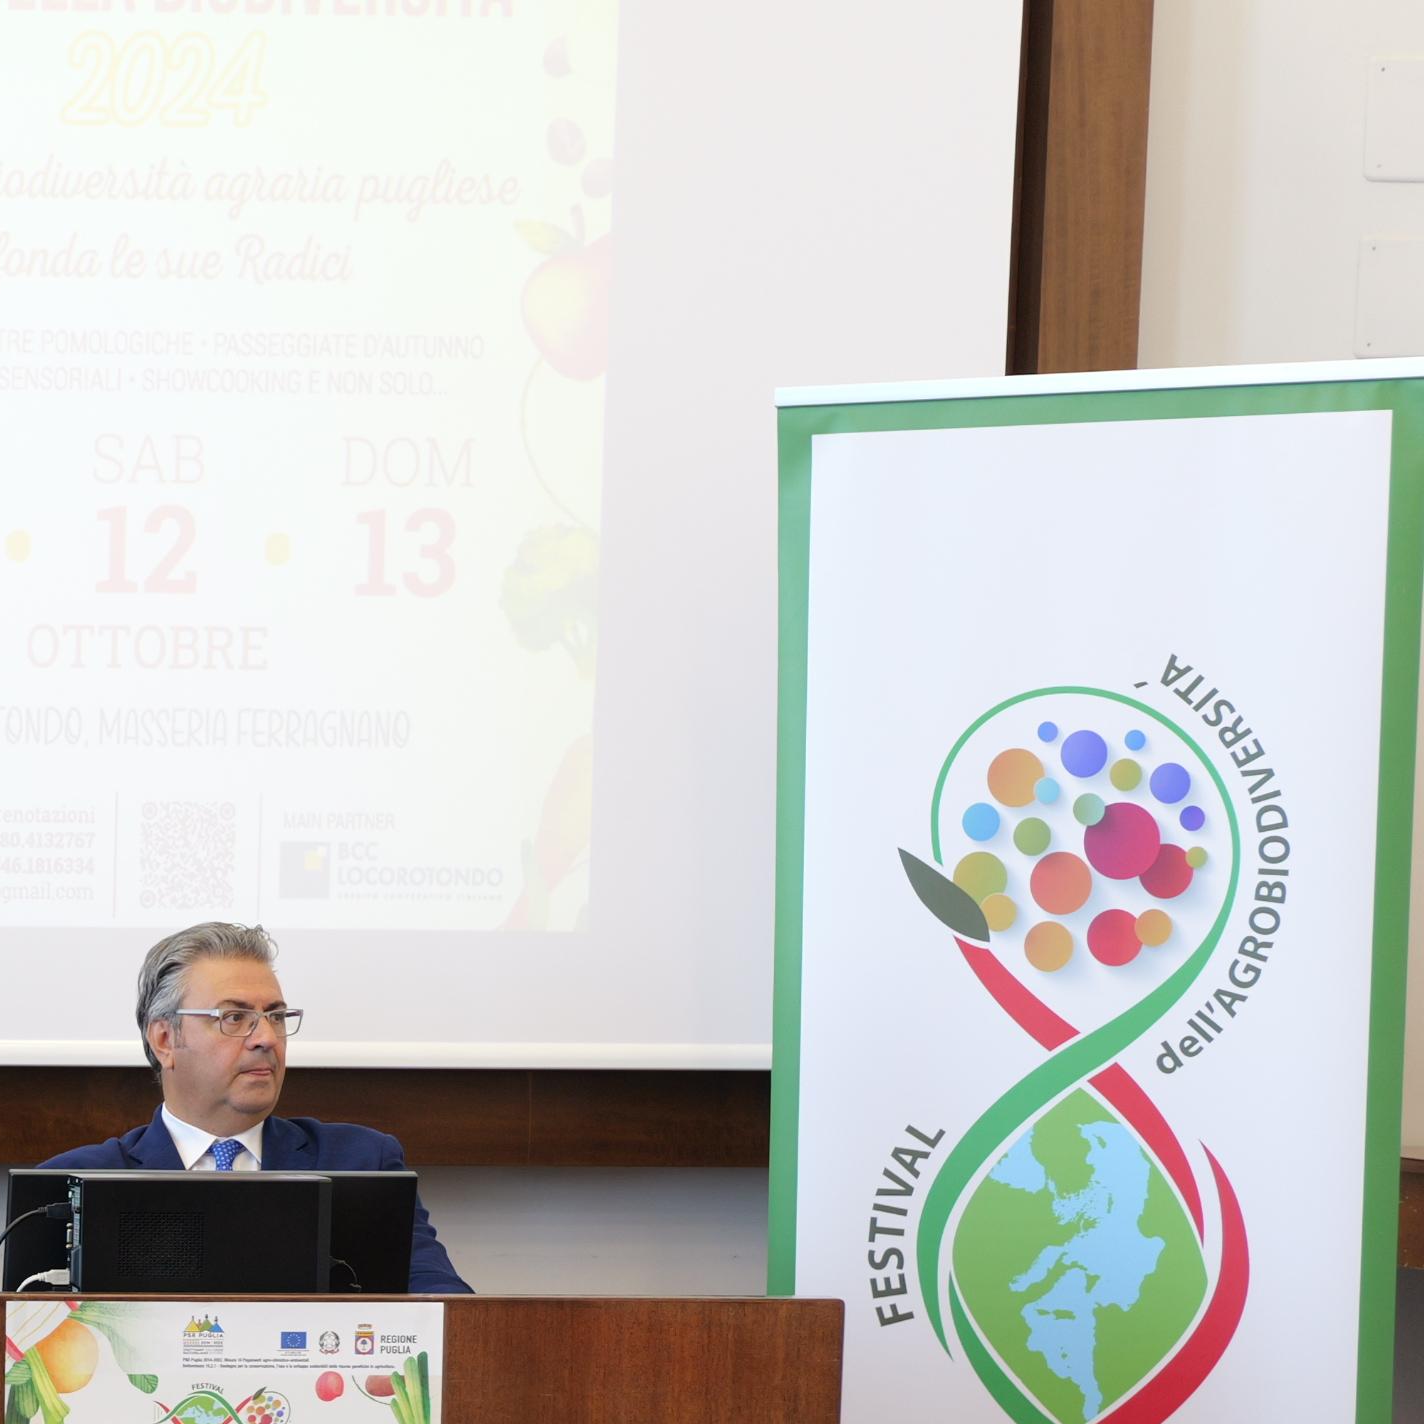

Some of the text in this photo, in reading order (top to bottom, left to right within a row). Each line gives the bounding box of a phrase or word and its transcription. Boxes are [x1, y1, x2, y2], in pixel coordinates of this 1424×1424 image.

[59, 28, 271, 129] 2024
[91, 433, 207, 486] SAB
[339, 437, 477, 490] DOM
[93, 503, 199, 595] 12
[353, 505, 459, 599] 13
[25, 623, 270, 672] OTTOBRE
[98, 705, 231, 749] MASSERIA
[235, 707, 412, 750] FERRAGNANO
[867, 1123, 947, 1328] FESTIVAL
[380, 1346, 411, 1354] PUGLIA
[381, 1335, 417, 1343] REGIONE
